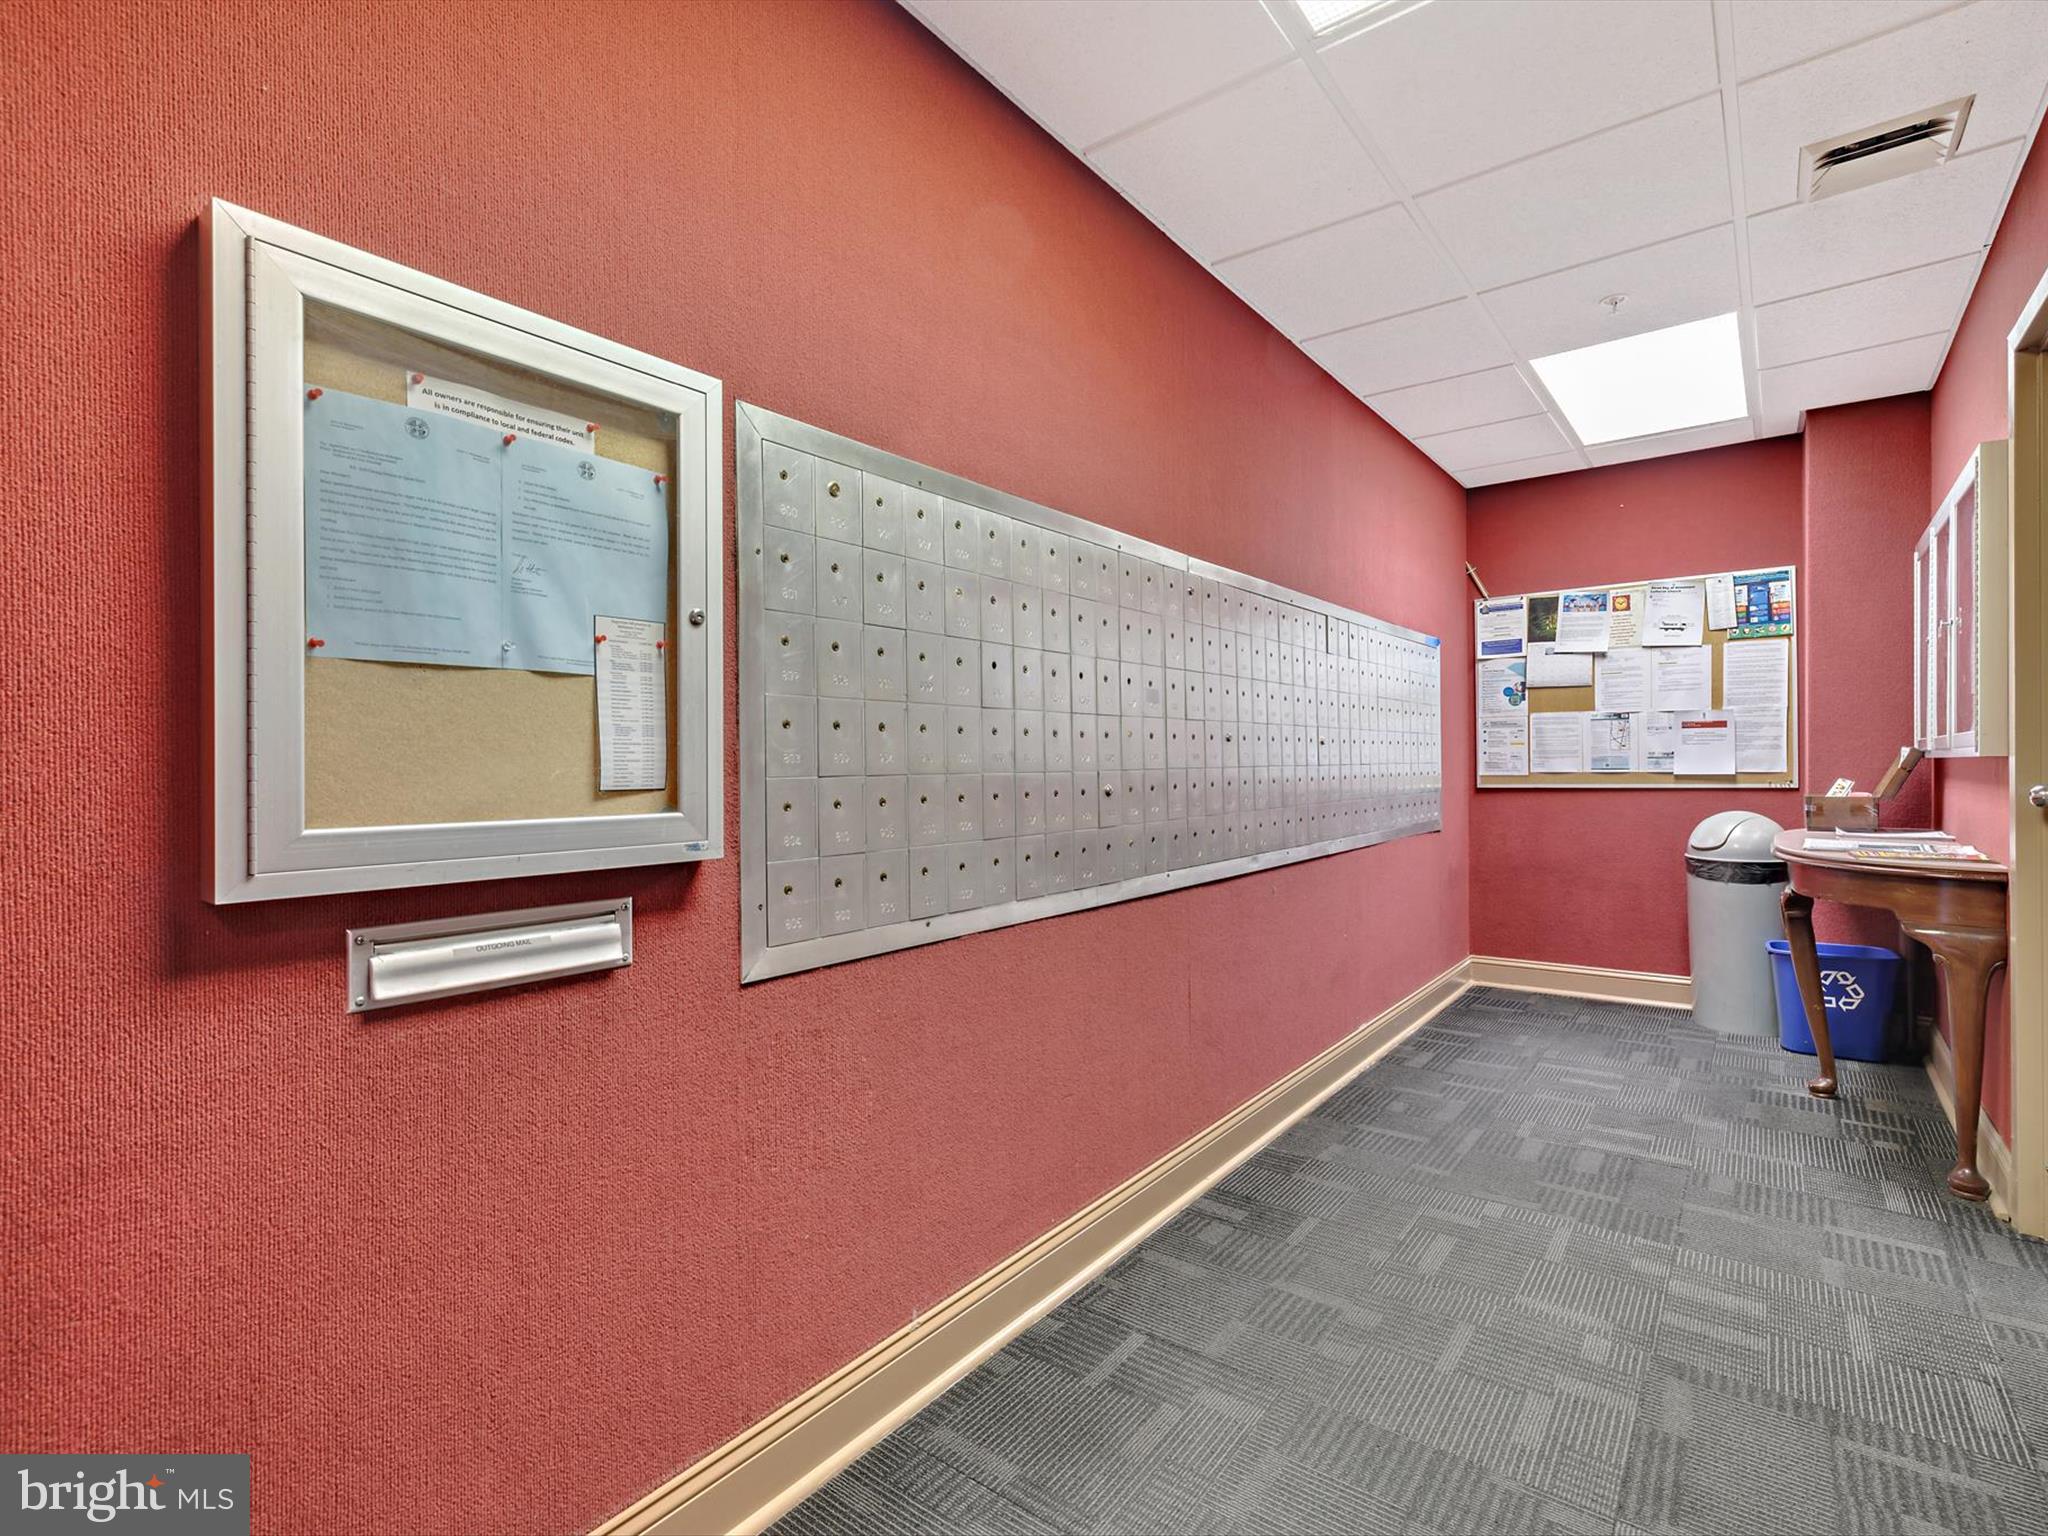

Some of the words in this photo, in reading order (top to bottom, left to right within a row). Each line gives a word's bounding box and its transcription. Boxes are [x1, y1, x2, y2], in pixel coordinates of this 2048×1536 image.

[422, 388, 433, 396] All
[434, 391, 462, 404] owners
[463, 399, 475, 407] are
[476, 402, 515, 418] responsible
[515, 413, 526, 422] for
[526, 418, 555, 431] ensuring
[555, 425, 571, 434] their
[571, 430, 584, 438] unit
[442, 403, 450, 411] in
[451, 407, 490, 423] compliance
[500, 420, 516, 430] local
[517, 426, 530, 435] and
[531, 428, 554, 440] federal
[555, 436, 575, 446] codes.
[475, 941, 515, 952] OUTGOING
